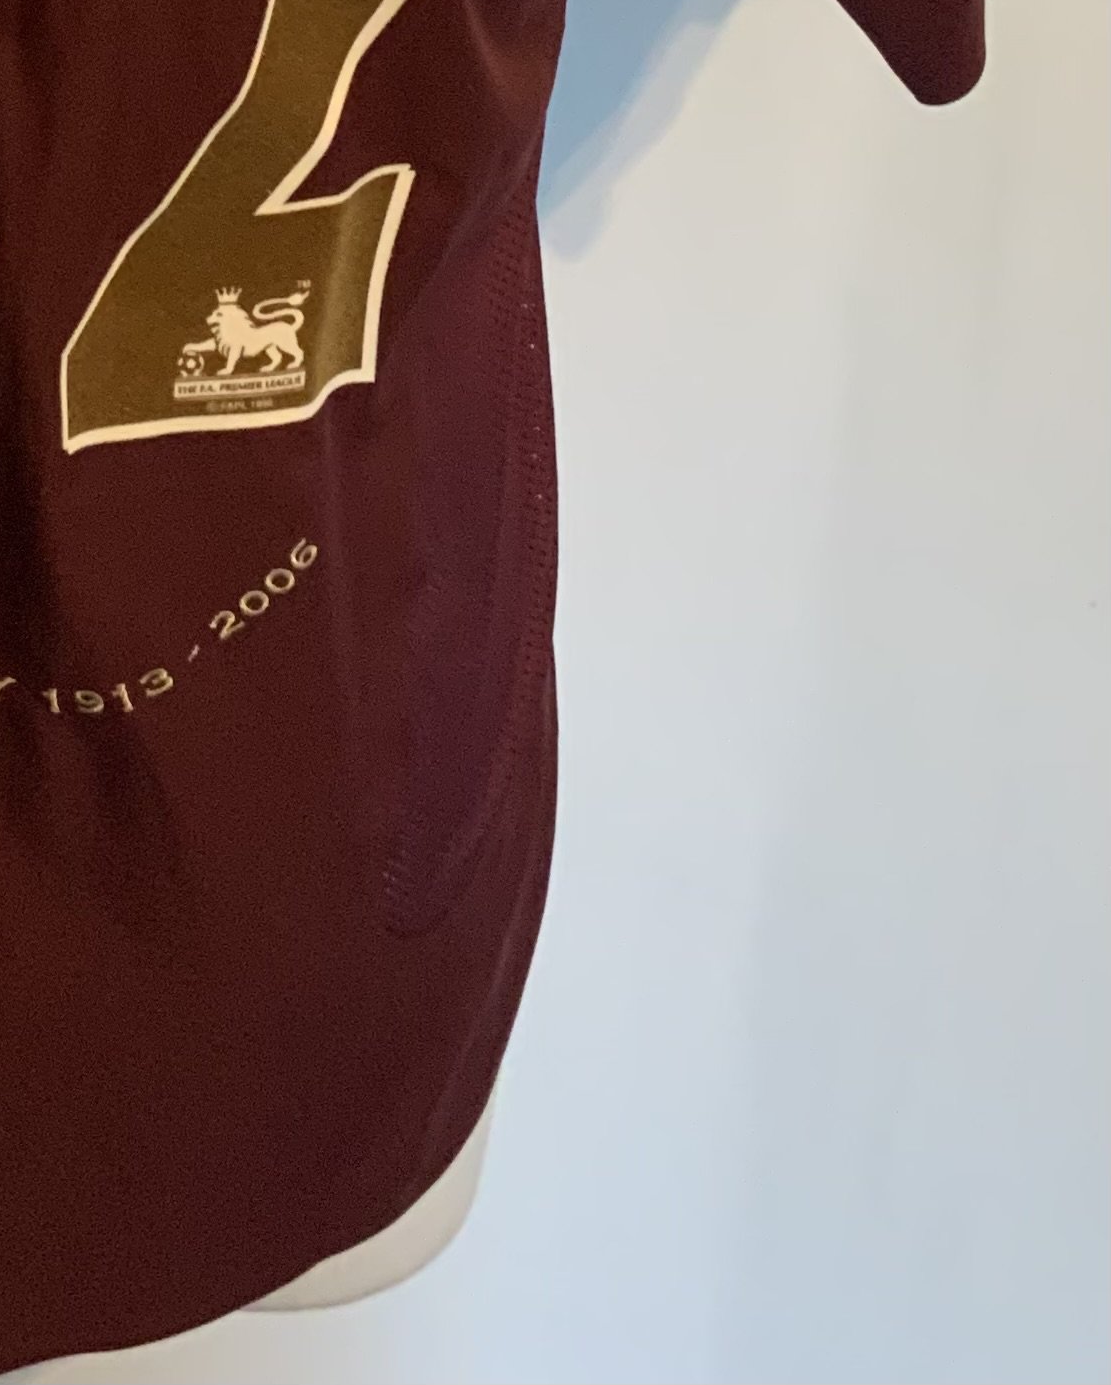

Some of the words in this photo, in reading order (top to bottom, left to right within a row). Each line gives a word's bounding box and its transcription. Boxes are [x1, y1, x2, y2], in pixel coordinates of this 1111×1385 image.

[219, 382, 263, 392] PREMIER
[265, 376, 302, 389] LEAGUE
[42, 667, 175, 714] 1913
[188, 644, 200, 663] -
[209, 537, 318, 641] 2006
